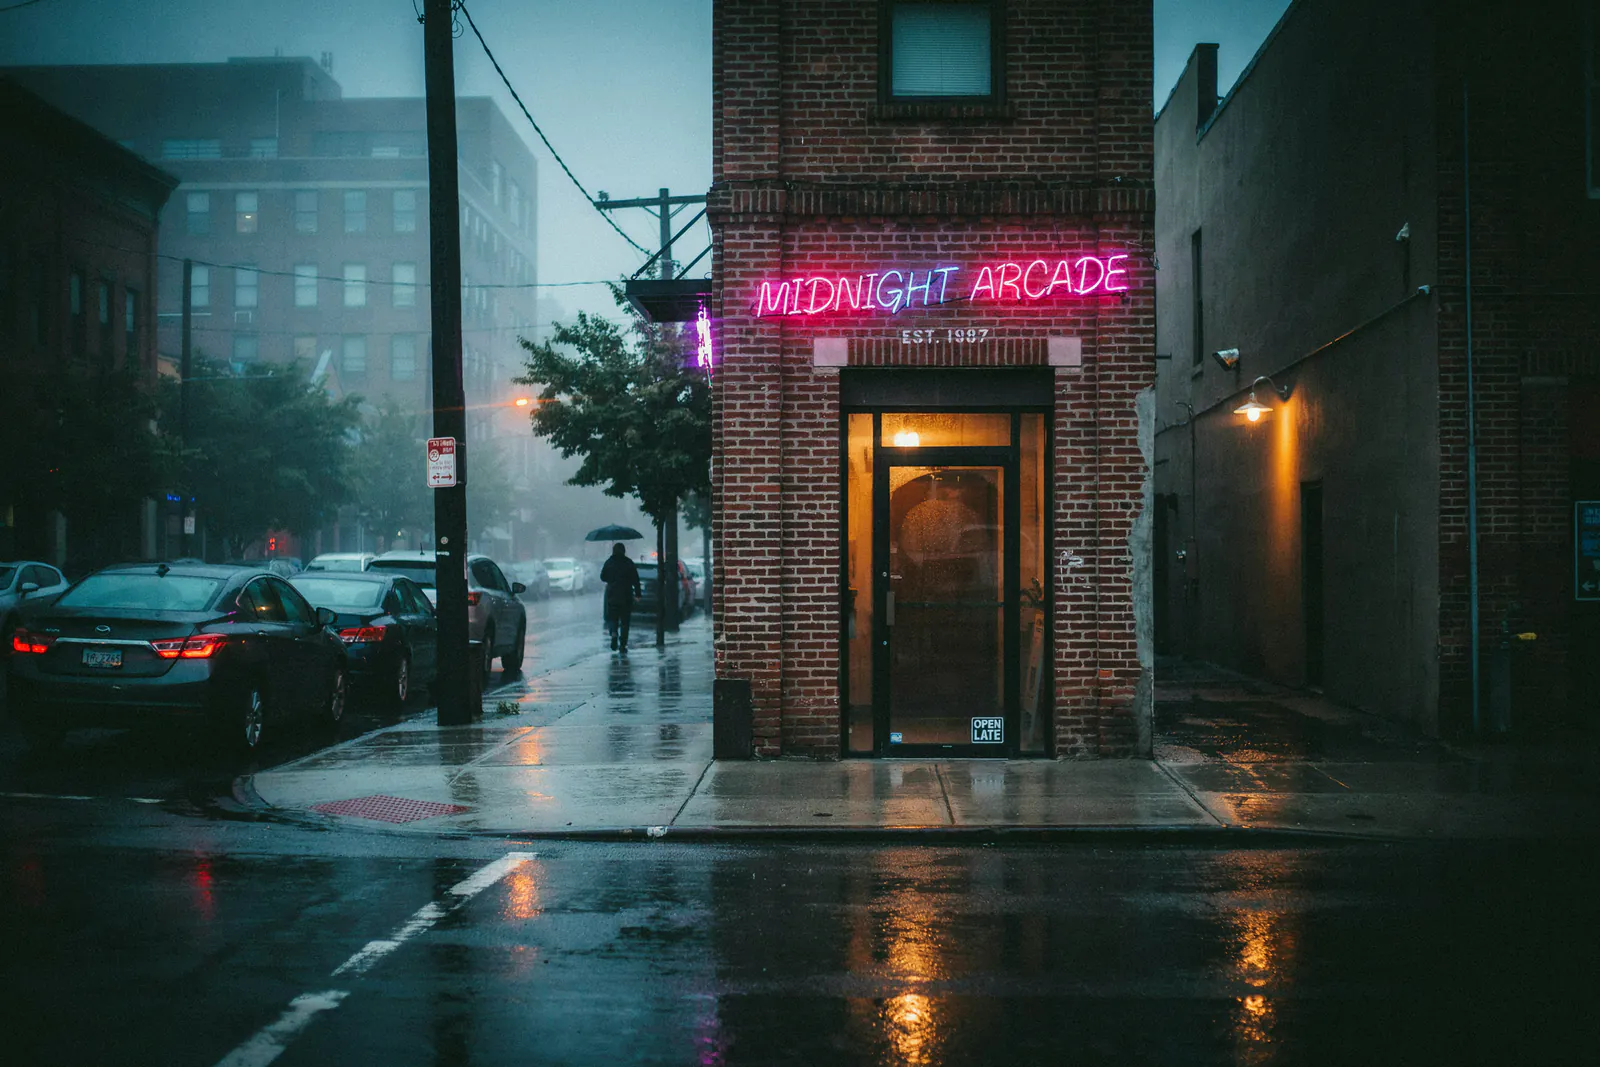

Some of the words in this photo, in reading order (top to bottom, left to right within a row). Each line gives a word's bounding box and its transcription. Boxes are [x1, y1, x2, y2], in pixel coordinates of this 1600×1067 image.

[756, 266, 959, 318] MIDNIGHT
[970, 254, 1129, 302] ARCADE
[902, 329, 940, 345] EST.
[947, 329, 989, 344] 1987
[973, 719, 1001, 729] OPEN
[973, 729, 1001, 740] LATE
